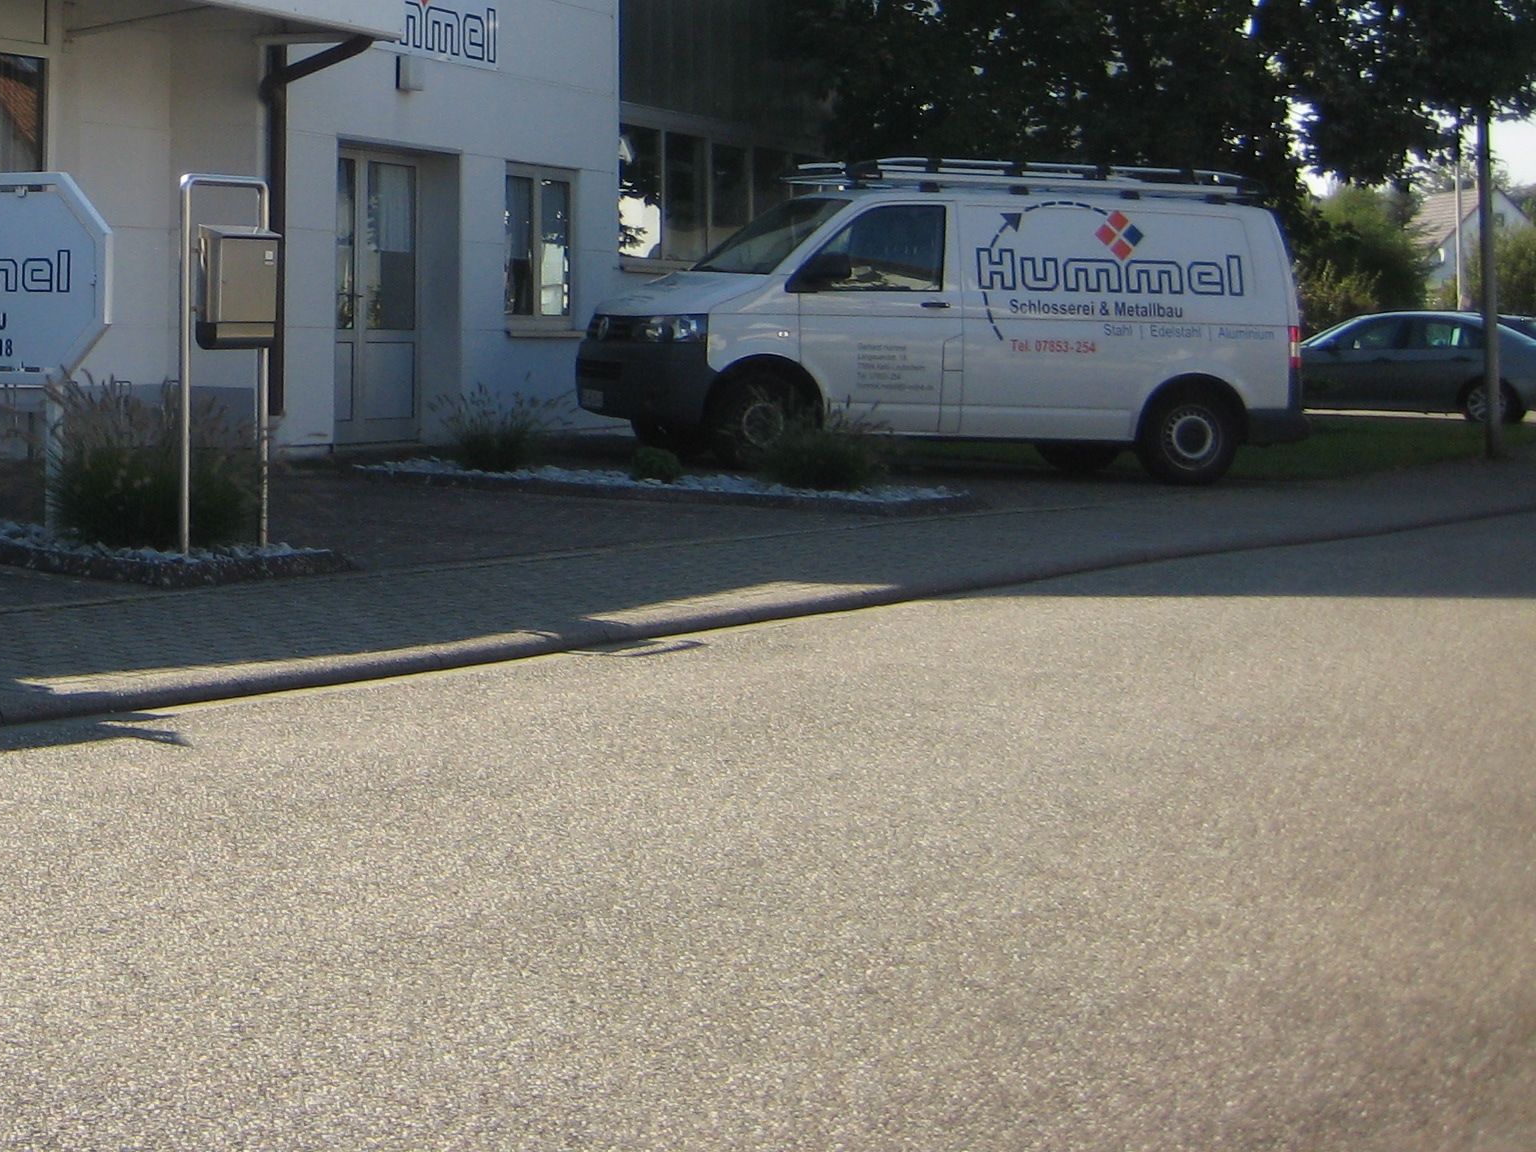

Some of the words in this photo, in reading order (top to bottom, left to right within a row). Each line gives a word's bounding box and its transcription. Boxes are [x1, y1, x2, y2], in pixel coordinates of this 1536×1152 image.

[976, 247, 1244, 297] Hummel
[1009, 299, 1095, 316] Schlosserei
[1099, 301, 1110, 317] &
[1115, 302, 1183, 319] Metallbau
[1103, 323, 1133, 337] Stahl
[1150, 324, 1202, 338] Edelstahl
[1218, 326, 1276, 341] Aluminium
[1010, 338, 1031, 352] Tel.
